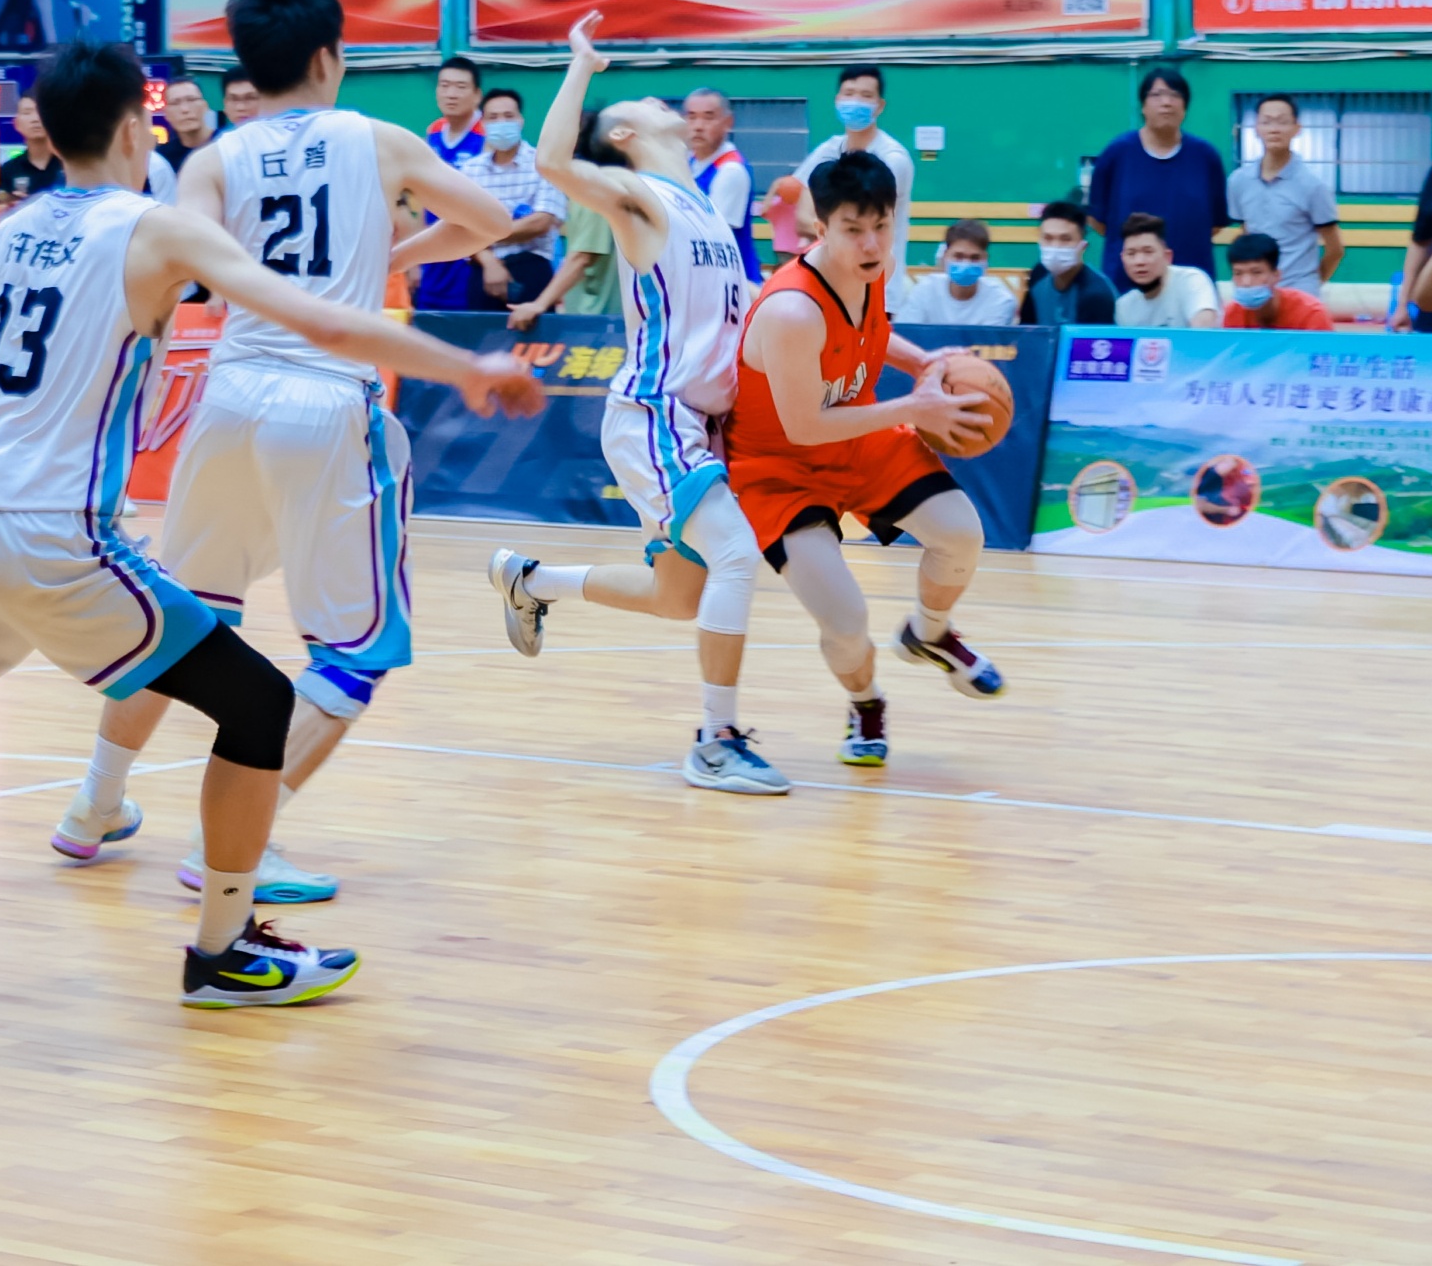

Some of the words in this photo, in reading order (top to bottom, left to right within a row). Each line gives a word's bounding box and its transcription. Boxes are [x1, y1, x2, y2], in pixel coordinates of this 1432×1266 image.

[260, 184, 333, 277] 21
[1308, 353, 1416, 379] 精品生活
